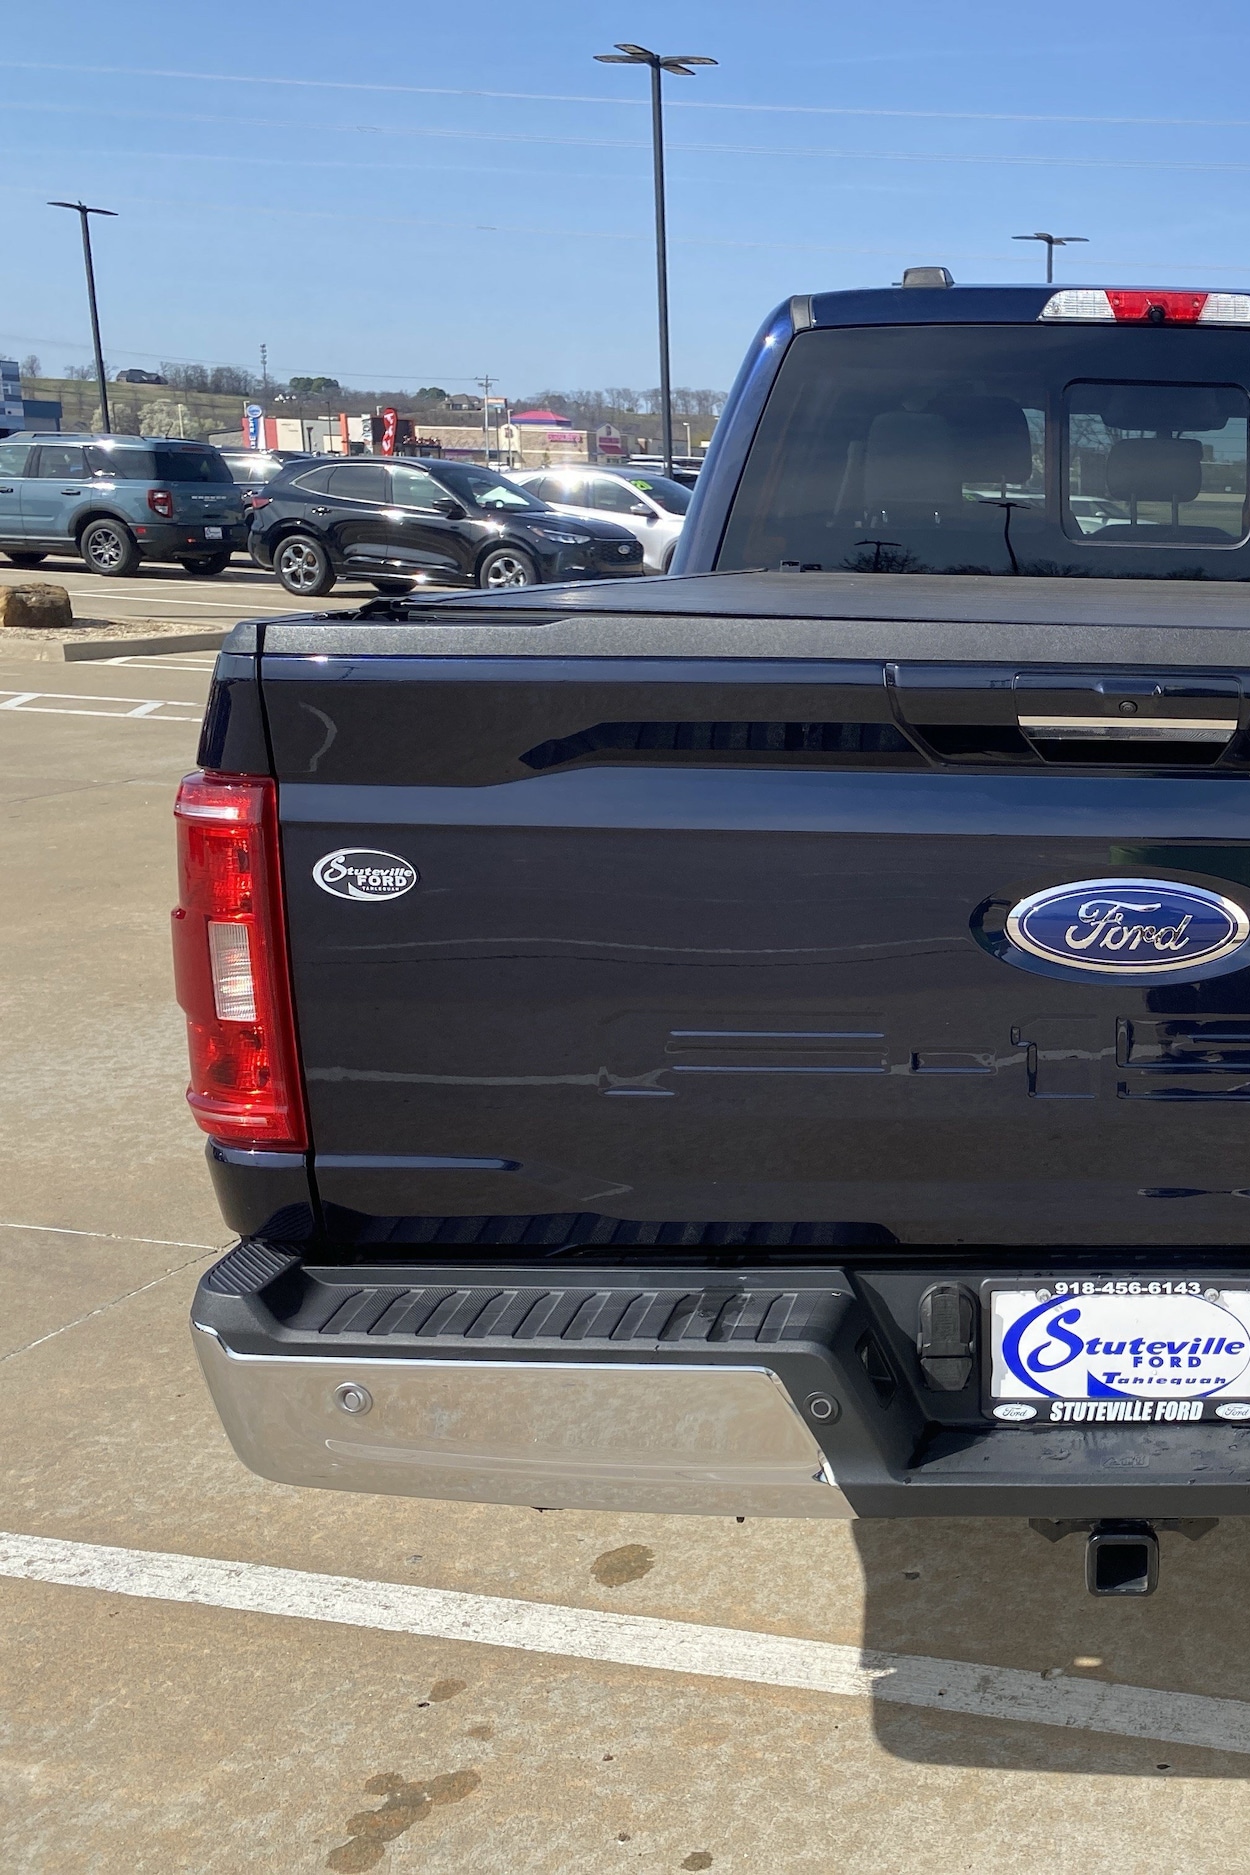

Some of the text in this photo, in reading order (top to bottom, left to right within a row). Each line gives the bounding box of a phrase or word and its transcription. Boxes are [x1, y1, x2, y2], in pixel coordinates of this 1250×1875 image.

[323, 855, 413, 883] Stuteville
[356, 874, 408, 887] FORD
[1064, 898, 1195, 951] Ford
[1054, 1281, 1201, 1295] 918-456-6143
[1026, 1308, 1246, 1373] Stuteville
[1132, 1356, 1202, 1368] FORD
[1101, 1371, 1227, 1385] Tahlequah
[1002, 1406, 1028, 1418] Ford
[1050, 1400, 1204, 1422] STUTEVILLE FORD
[1224, 1406, 1250, 1417] Ford
